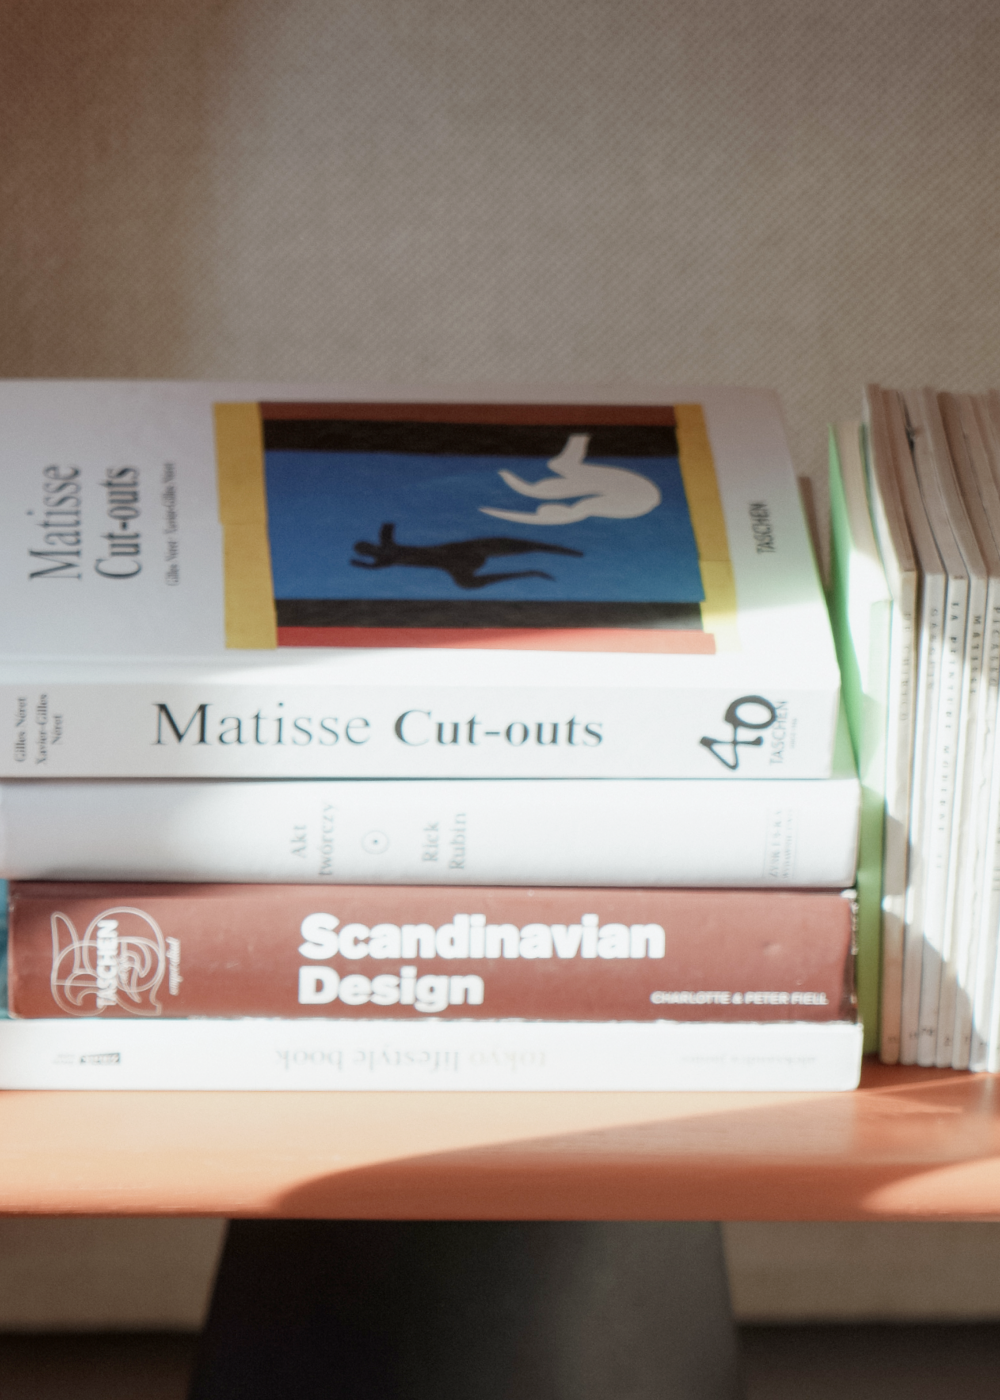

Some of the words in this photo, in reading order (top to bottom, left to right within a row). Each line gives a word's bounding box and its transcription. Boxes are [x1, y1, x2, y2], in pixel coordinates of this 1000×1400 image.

[26, 465, 82, 581] Matisse
[94, 466, 142, 580] Cut-outs
[748, 503, 776, 554] TASCHEN
[13, 731, 27, 763] Gilles
[151, 702, 371, 746] Matisse
[394, 709, 604, 747] Cut-outs
[698, 695, 776, 771] 40
[769, 700, 789, 766] TASCHEN
[289, 824, 307, 859] Akt
[317, 802, 338, 877] twórczy
[422, 821, 440, 863] Rick
[448, 812, 467, 871] Rubin
[298, 912, 666, 960] Scandinavian
[97, 919, 119, 1008] TASCHEN
[299, 966, 485, 1013] Design
[650, 991, 731, 1005] CHARLOTTE
[732, 992, 743, 1005] &
[745, 991, 790, 1005] PETER
[791, 992, 829, 1006] FIELL
[275, 1050, 344, 1073] book
[353, 1044, 460, 1074] lifestyle
